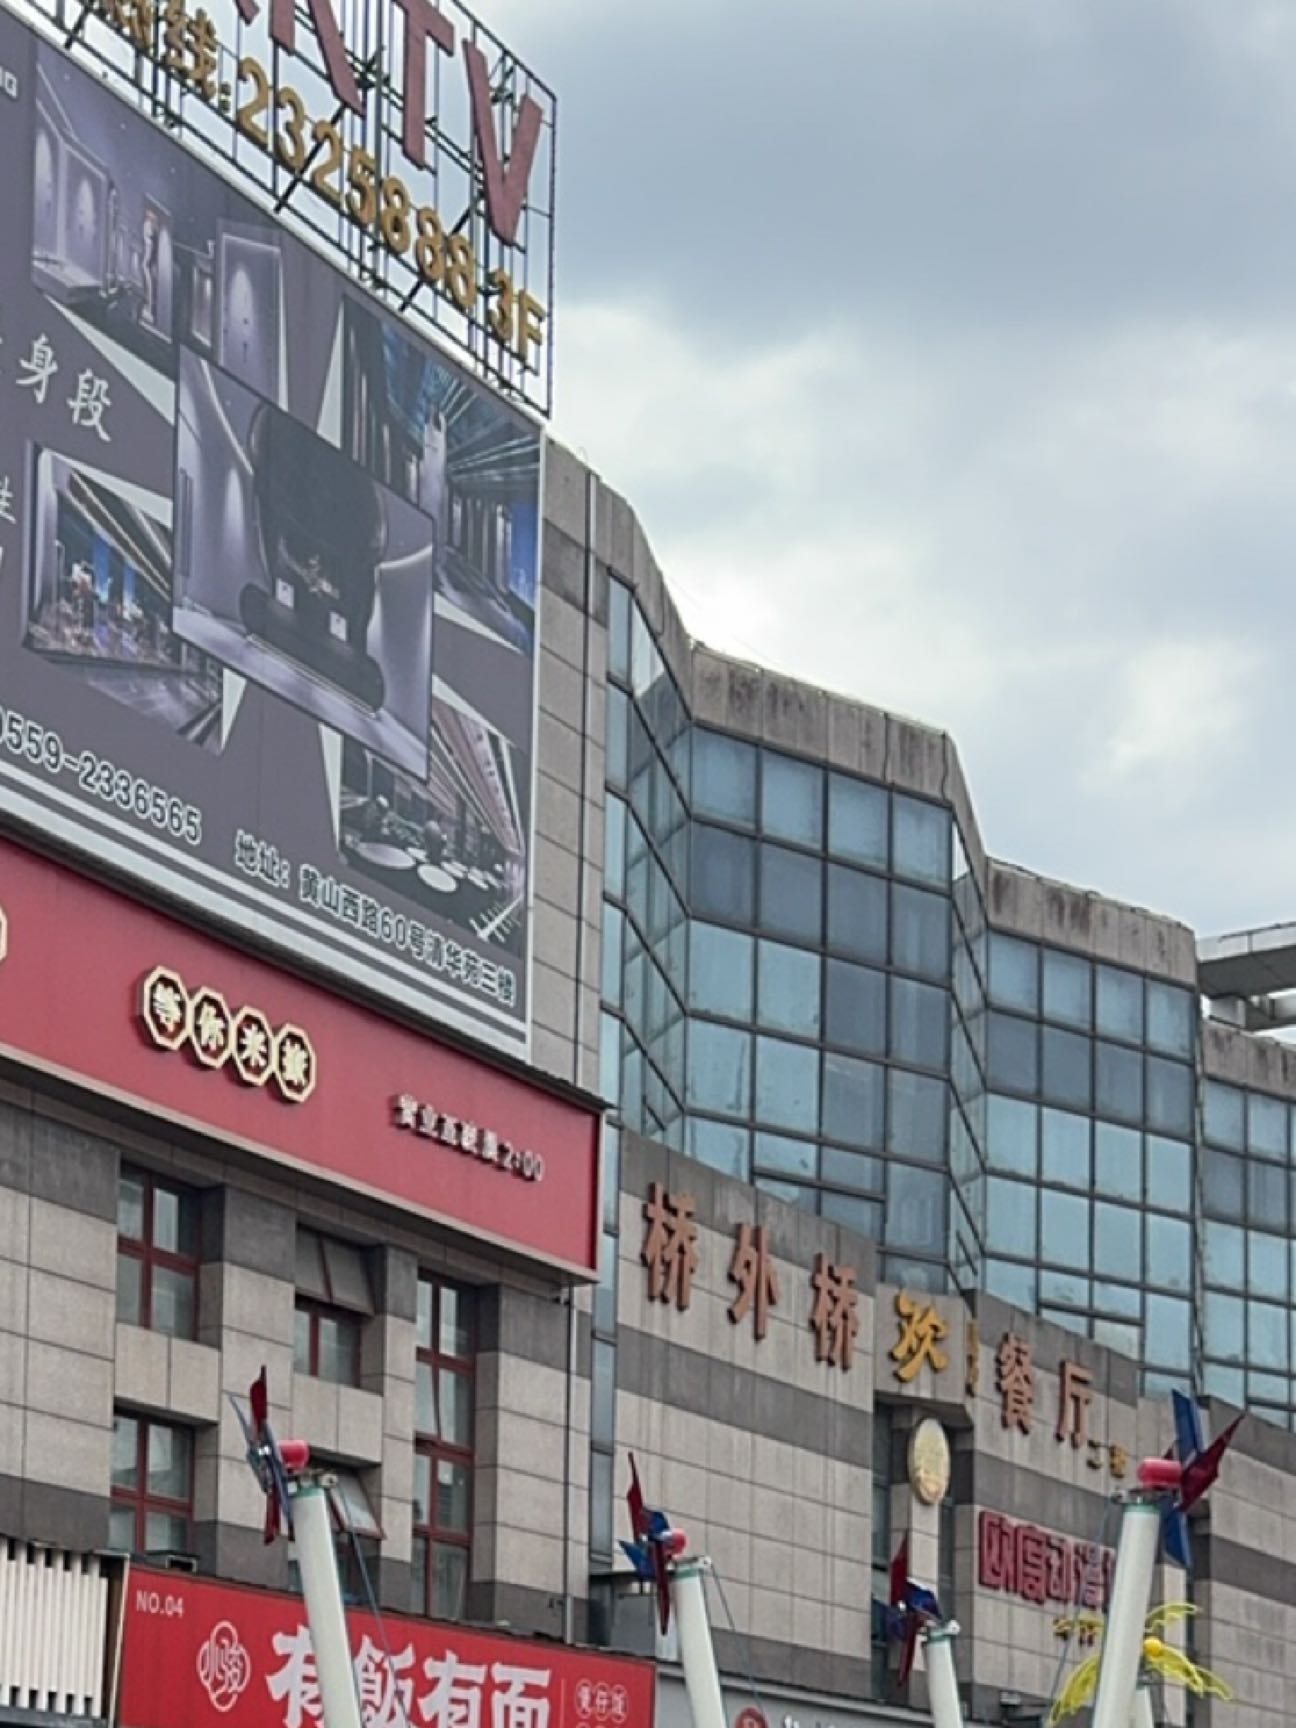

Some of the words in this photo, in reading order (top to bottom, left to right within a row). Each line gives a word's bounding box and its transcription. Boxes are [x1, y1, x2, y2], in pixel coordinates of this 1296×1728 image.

[488, 270, 546, 366] 3F
[641, 1182, 859, 1371] 桥外桥
[996, 1332, 1094, 1449] 餐厅
[136, 1589, 185, 1618] NO.04
